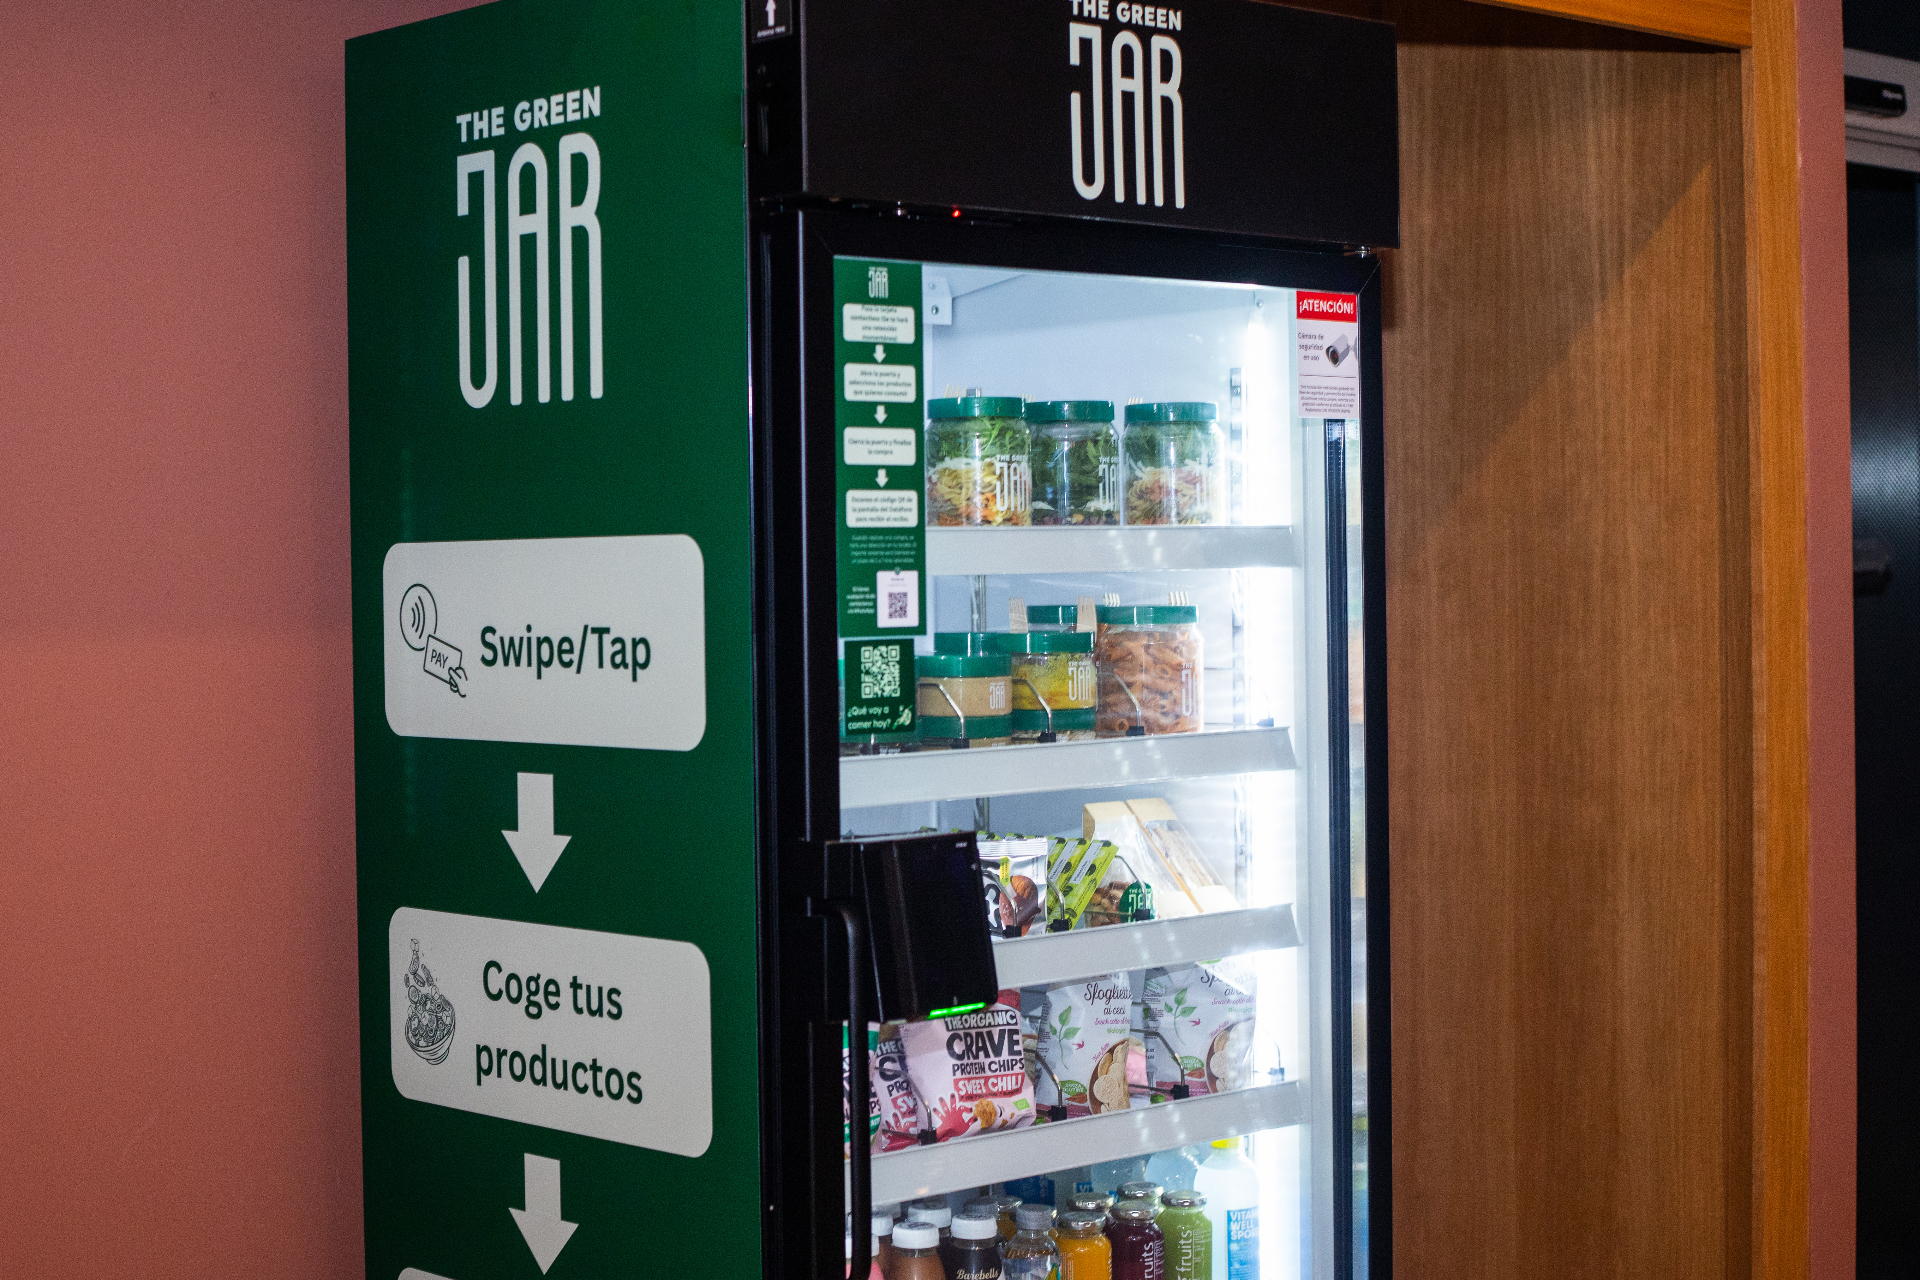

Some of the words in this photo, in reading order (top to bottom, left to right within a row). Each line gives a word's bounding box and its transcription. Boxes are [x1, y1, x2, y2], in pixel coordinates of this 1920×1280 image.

[1069, 0, 1110, 20] THE
[1116, 1, 1182, 31] GREEN
[456, 106, 505, 143] THE
[514, 85, 600, 131] GREEN
[1069, 21, 1185, 209] JAR
[457, 132, 603, 408] JAR
[1299, 298, 1354, 314] ¡ATENCIÓN!
[430, 649, 449, 669] PAY
[480, 624, 651, 683] Swipe/Tap
[989, 685, 1005, 710] JAR
[1068, 666, 1091, 701] JAR
[848, 721, 872, 730] comer
[872, 718, 891, 730] hoy?
[868, 706, 882, 716] voy
[483, 960, 561, 1019] Coge
[570, 975, 623, 1020] tus
[962, 1010, 1017, 1029] ORGANIC
[946, 1029, 1022, 1061] CRAVE
[475, 1043, 643, 1105] productos
[952, 1061, 986, 1076] PROTEIN
[988, 1058, 1024, 1073] CHIPS
[958, 1079, 986, 1096] SWEET
[988, 1074, 1022, 1092] CHILI
[1230, 1220, 1254, 1230] WELL
[1230, 1227, 1258, 1240] SPOR
[1140, 1242, 1154, 1280] ruits
[1176, 1230, 1192, 1272] fruits
